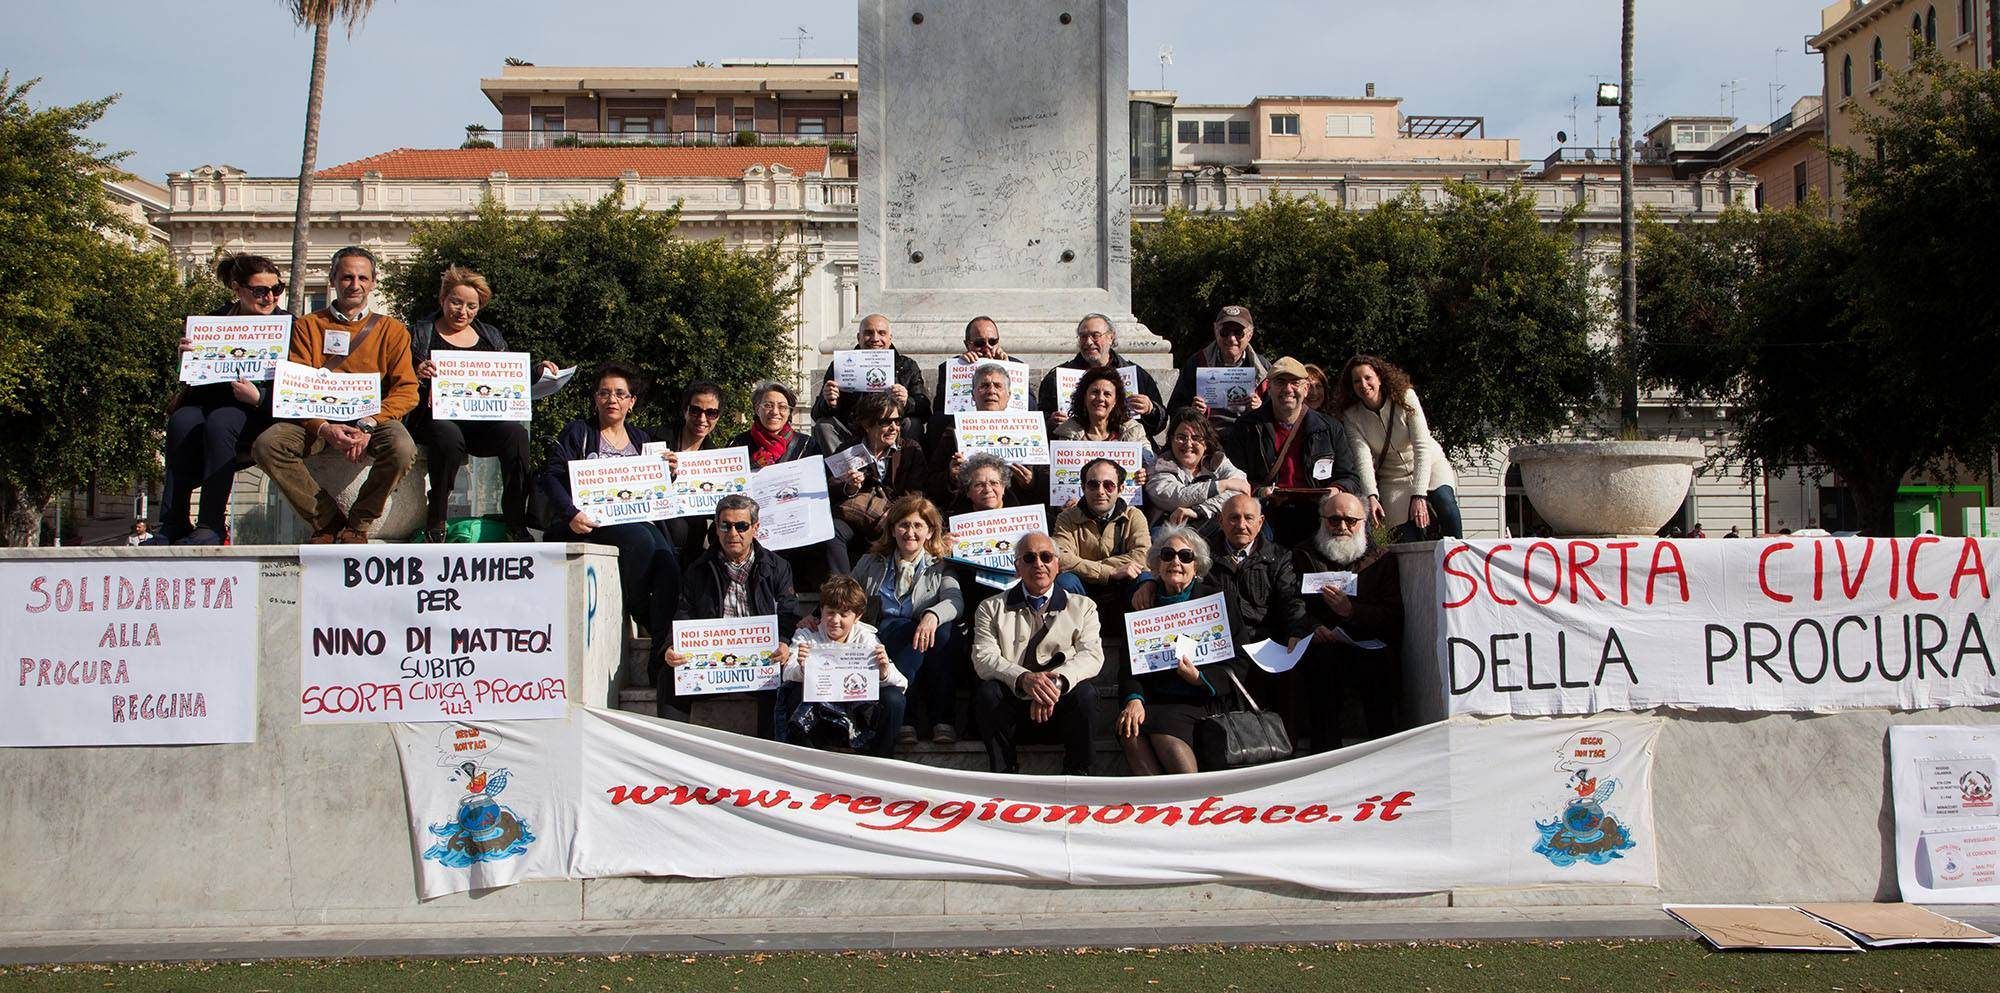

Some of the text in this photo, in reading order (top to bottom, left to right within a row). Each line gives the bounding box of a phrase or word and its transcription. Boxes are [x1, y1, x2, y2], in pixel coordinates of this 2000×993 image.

[1048, 149, 1089, 178] HOLA
[193, 332, 283, 341] NINO DI MATTEO
[194, 324, 283, 333] NOI SIAMO TUTTI
[214, 361, 262, 374] UBUNTU
[439, 360, 523, 369] NOI SIAMO TUTTI
[304, 375, 338, 385] SIAMO
[439, 369, 523, 378] NINO DI MATTEO
[282, 379, 310, 390] NINO
[327, 384, 373, 392] MATTEO
[306, 404, 355, 416] UBUNTU
[463, 399, 507, 412] UBUNTU
[682, 456, 742, 467] SIAMO TUTTI
[1107, 450, 1135, 458] TUTTI
[577, 464, 661, 477] NOI SIAMO TUTTI
[691, 468, 701, 476] DI
[703, 465, 743, 474] MATTEO
[578, 472, 663, 486] NINO DI MATTEO
[605, 501, 651, 517] UBUNTU
[655, 499, 670, 507] NO
[957, 514, 1039, 530] NOI SIAMO TUTTI
[957, 529, 983, 538] NINO
[999, 522, 1040, 533] MATTEO
[343, 555, 536, 588] BOMB JAMMER
[1442, 537, 1991, 609] SCORTA CIVICA
[416, 587, 463, 615] PER
[1133, 603, 1219, 628] NOI SIAMO TUTTI
[1134, 625, 1161, 636] NINO
[1177, 611, 1221, 627] MATTEO
[98, 621, 162, 649] ALLA
[312, 623, 553, 658] NINO DI MATTEO!
[681, 626, 770, 639] NOI SIAMO TUTTI
[681, 639, 709, 648] NINO
[726, 635, 771, 646] MATTEO
[1213, 639, 1227, 649] NO
[1447, 611, 1997, 696] DELLA PROCURA
[18, 656, 131, 688] PROCURA
[400, 655, 476, 680] SUBITO
[707, 668, 755, 684] UBUNTU
[760, 667, 775, 676] NO
[301, 676, 568, 715] SCORTA CIVICA PROCURA
[111, 692, 208, 724] REGGINA
[439, 698, 473, 716] ALLA
[605, 784, 1417, 833] www.reggionontace.it
